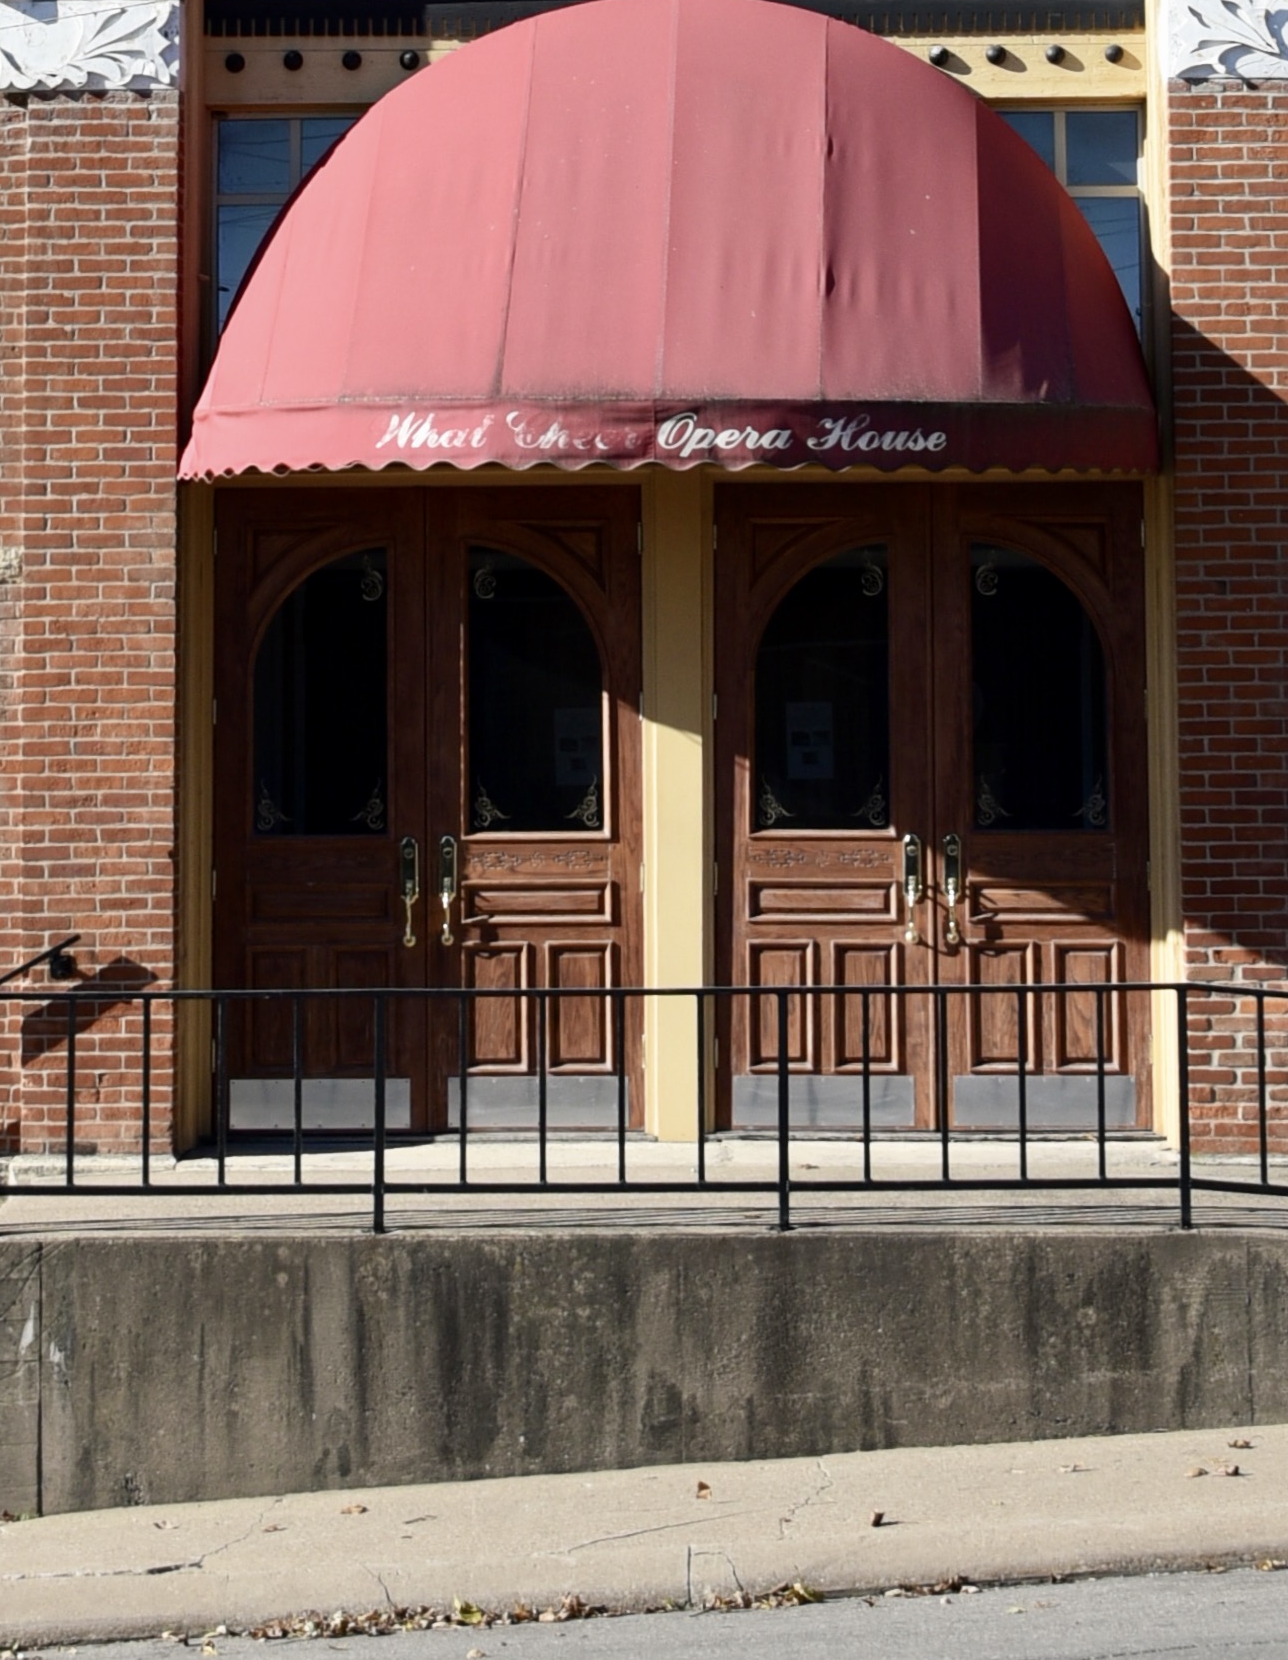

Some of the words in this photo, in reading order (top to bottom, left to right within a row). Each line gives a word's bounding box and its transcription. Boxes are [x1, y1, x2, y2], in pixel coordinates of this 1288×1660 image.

[375, 412, 495, 449] What
[657, 413, 793, 458] Opera
[807, 414, 947, 451] House
